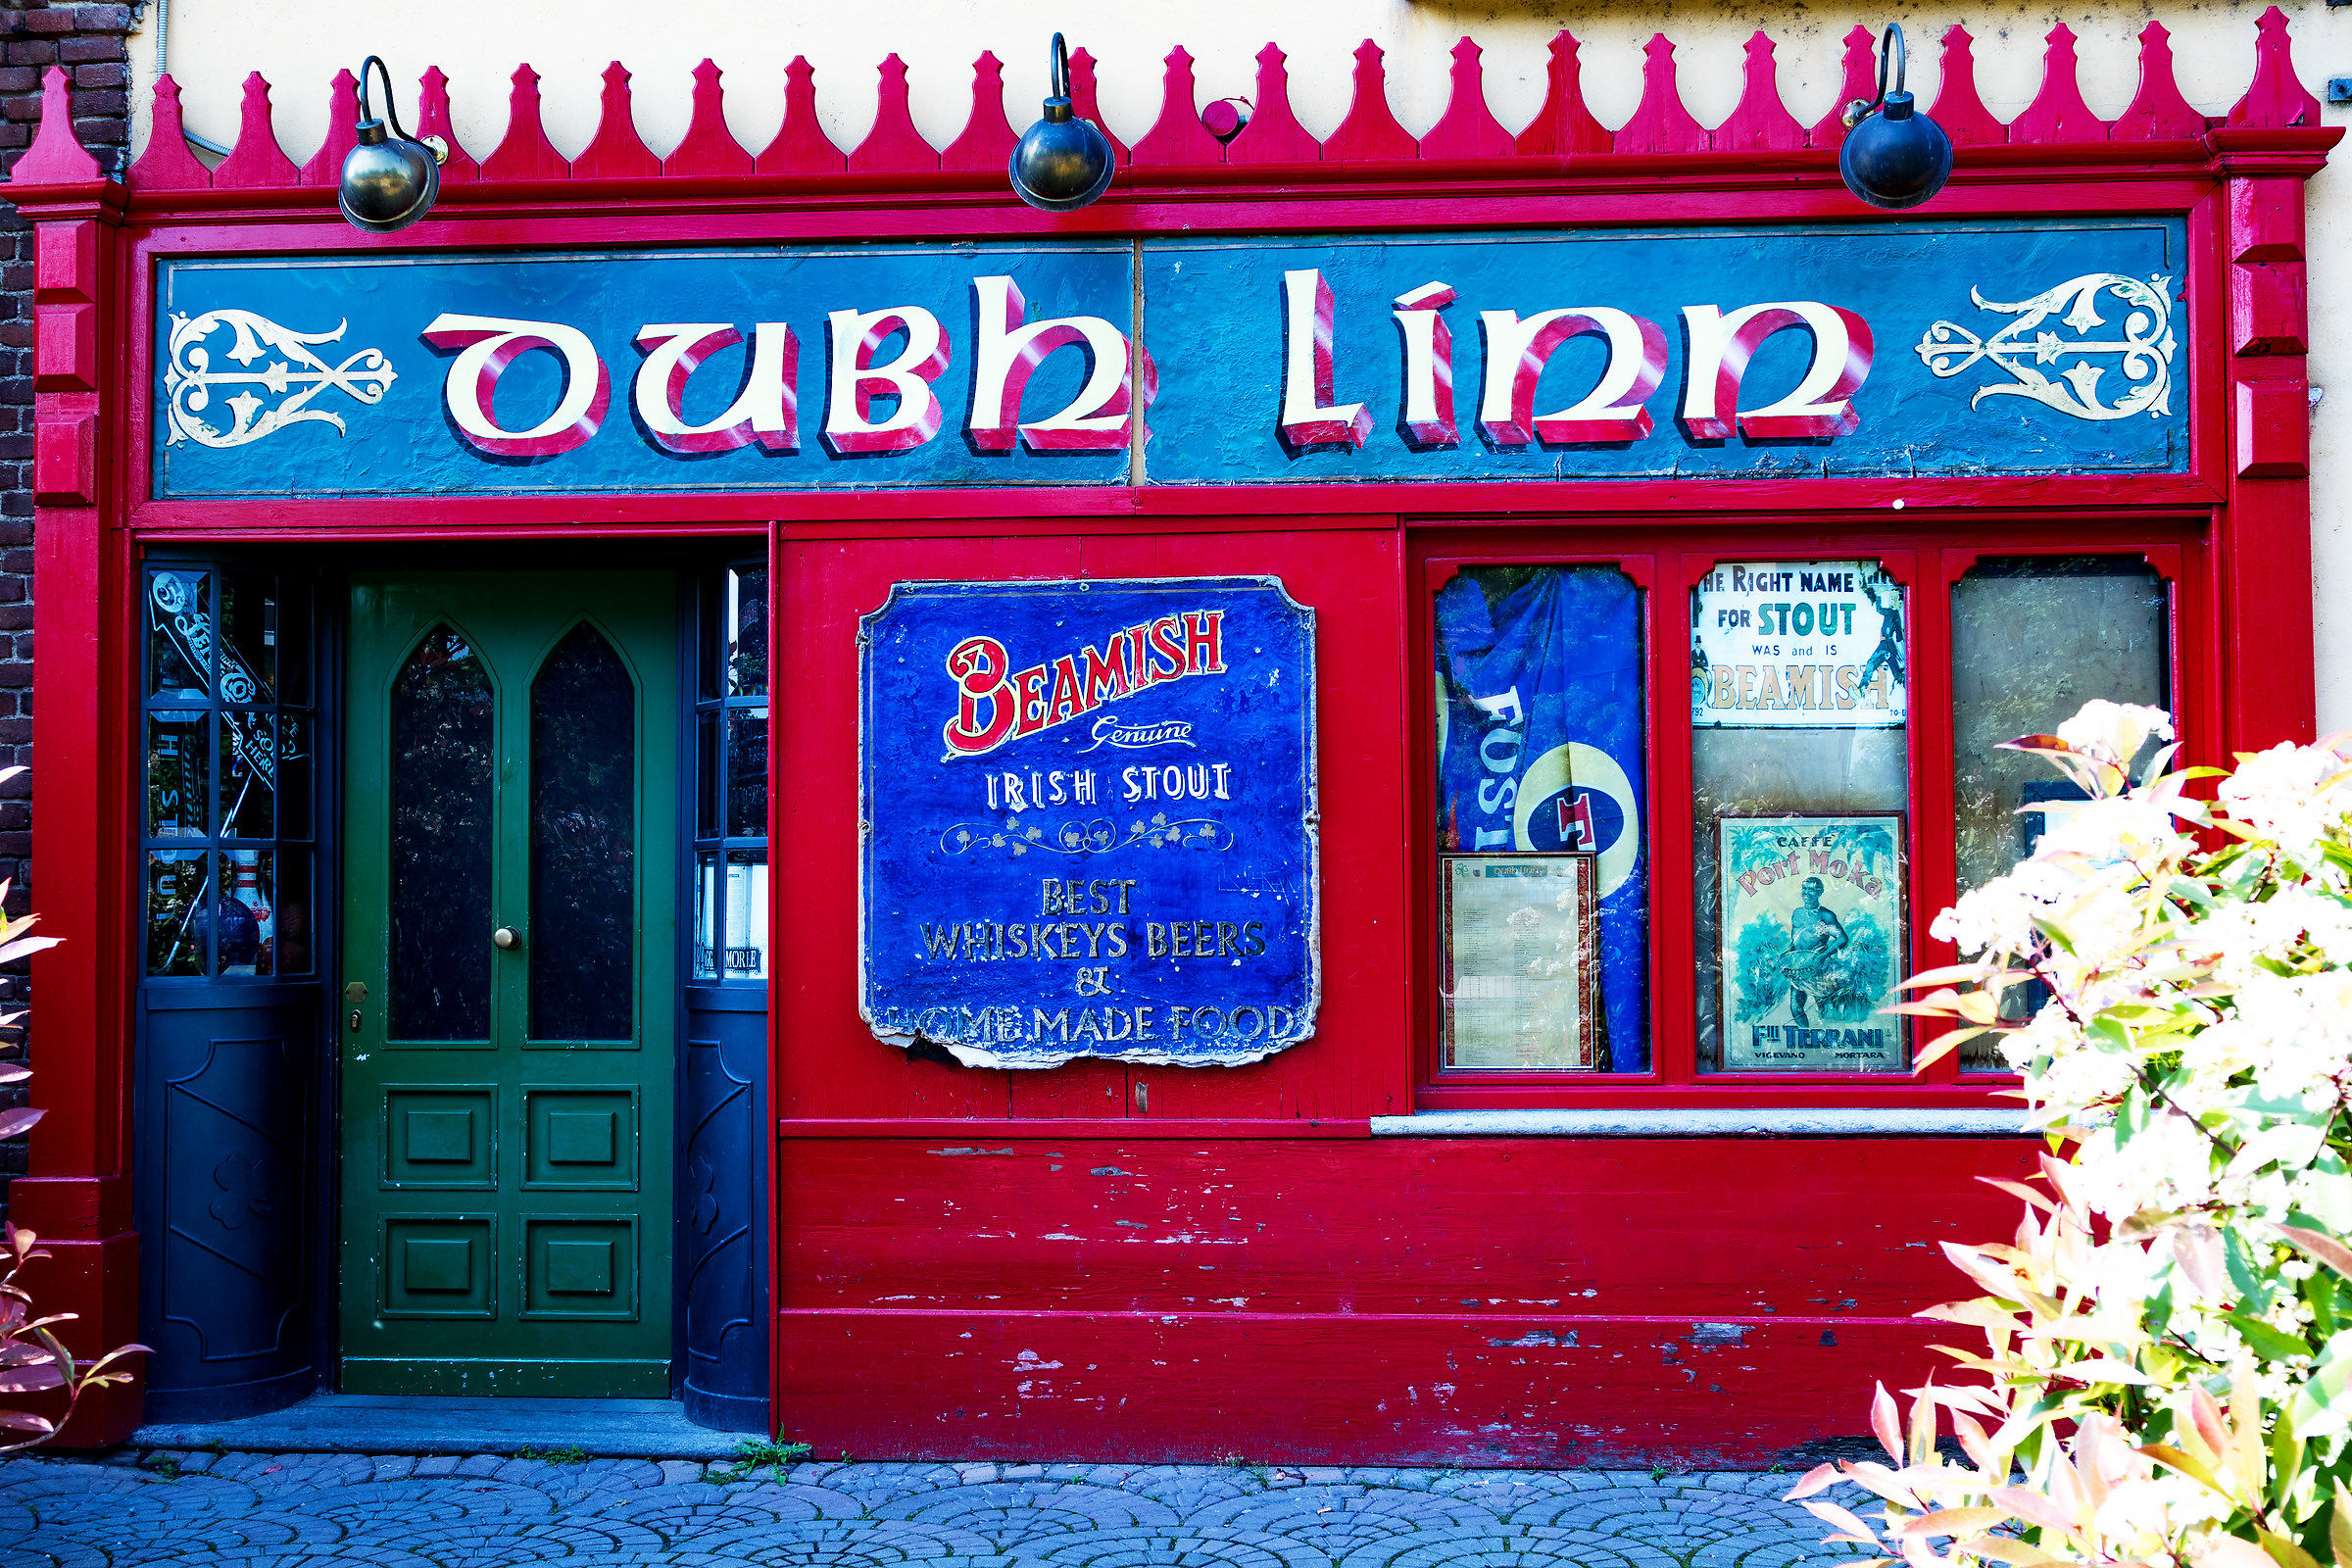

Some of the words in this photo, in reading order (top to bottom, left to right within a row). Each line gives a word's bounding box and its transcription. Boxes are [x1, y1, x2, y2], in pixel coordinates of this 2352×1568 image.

[1703, 572, 1725, 592] HE
[1800, 572, 1854, 593] NAME
[1718, 610, 1751, 627] FOR
[1758, 602, 1856, 636] STOUT
[1752, 645, 1781, 656] WAS
[1791, 646, 1813, 657] and
[1826, 645, 1838, 656] IS
[942, 610, 1227, 762] BEAMISH
[1712, 664, 1889, 710] BEAMISH
[1077, 715, 1197, 753] Genuine
[984, 769, 1099, 812] IRISH
[1122, 763, 1232, 801] STOUT
[1737, 850, 1800, 898] Port
[1041, 878, 1137, 915] BEST
[919, 921, 1128, 959] WHISKEYS
[1147, 920, 1266, 958] BEERS
[1075, 966, 1115, 997] &
[1033, 1006, 1156, 1042] MADE
[1171, 1004, 1295, 1040] FOOD
[1783, 1025, 1884, 1049] TERRANI
